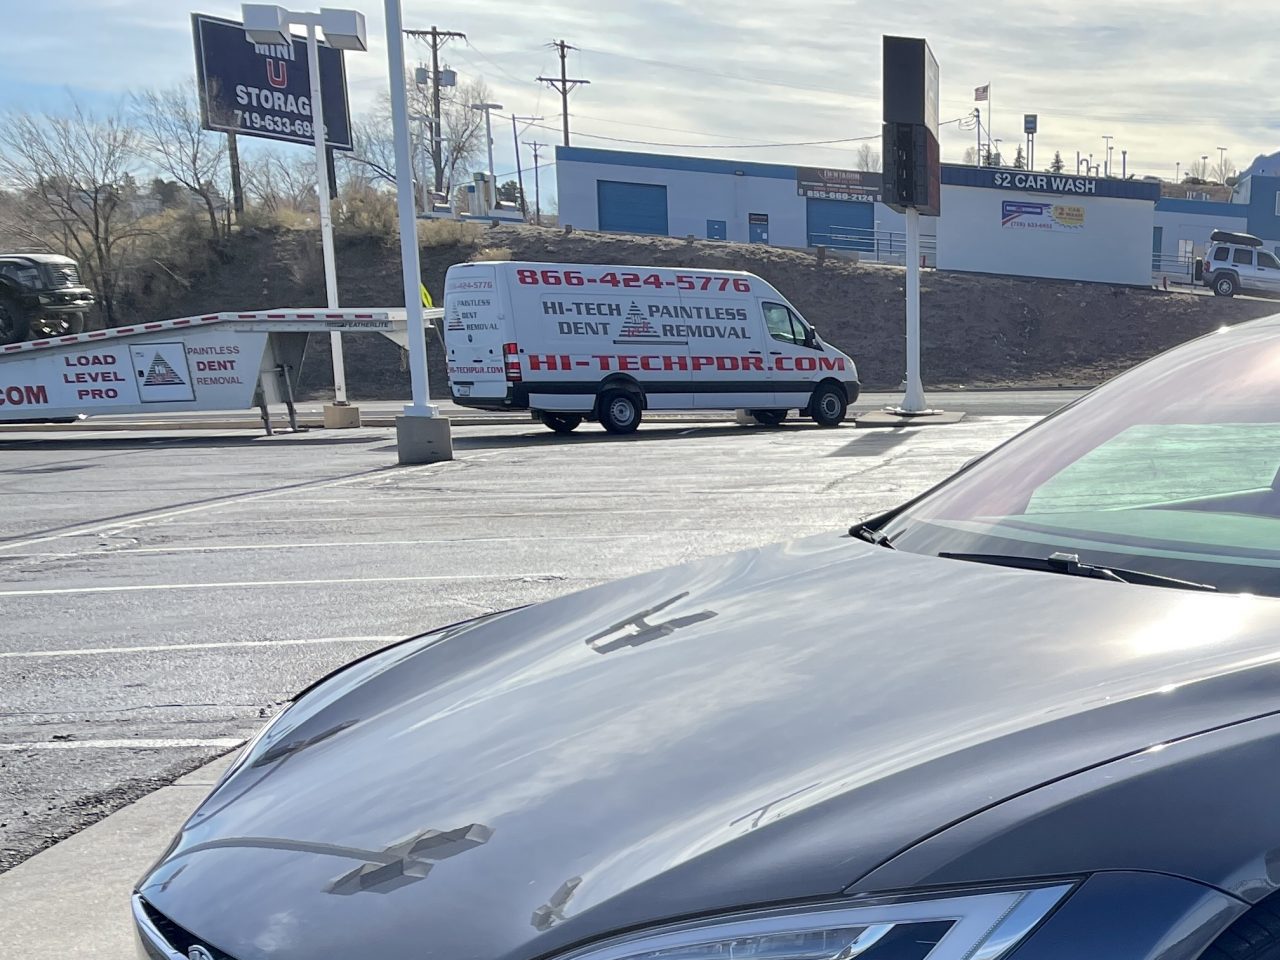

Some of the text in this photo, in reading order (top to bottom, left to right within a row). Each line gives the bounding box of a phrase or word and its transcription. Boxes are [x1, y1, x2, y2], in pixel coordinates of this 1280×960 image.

[266, 58, 288, 89] U
[235, 84, 312, 116] STORAG
[994, 173, 1096, 193] $2 CAR WASH
[516, 269, 750, 292] 866-424-5776
[542, 301, 747, 321] HI-TECH PAINTLESS
[466, 322, 499, 331] REMOVAL
[558, 321, 610, 336] DENT
[661, 324, 751, 339] REMOVAL
[187, 345, 240, 355] PAINTLESS
[64, 354, 116, 367] LOAD
[196, 360, 236, 371] DENT
[528, 354, 845, 371] HI-TECHPDR.COM
[63, 371, 126, 383] LEVEL
[197, 376, 244, 385] REMOVAL
[0, 385, 48, 406] OM
[77, 388, 118, 400] PRO
